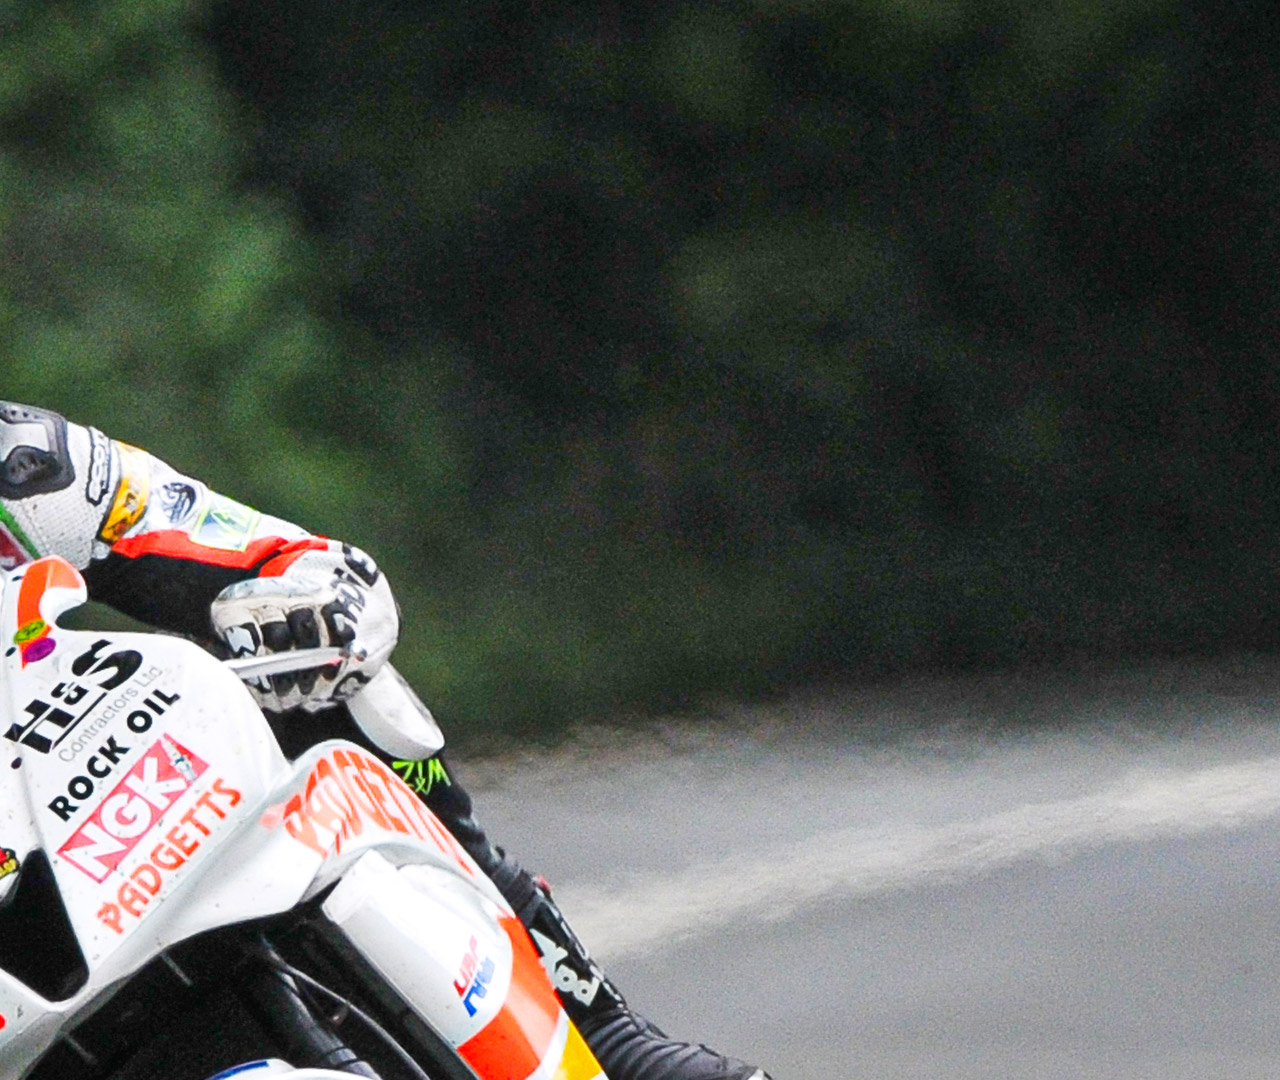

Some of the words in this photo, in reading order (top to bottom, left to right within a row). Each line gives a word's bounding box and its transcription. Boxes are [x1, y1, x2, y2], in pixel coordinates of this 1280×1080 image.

[48, 735, 130, 823] ROCK
[126, 688, 181, 736] OIL
[57, 684, 140, 764] Contractors
[134, 664, 165, 688] Ltd
[61, 753, 188, 880] NGK
[95, 778, 242, 936] PADGETTS
